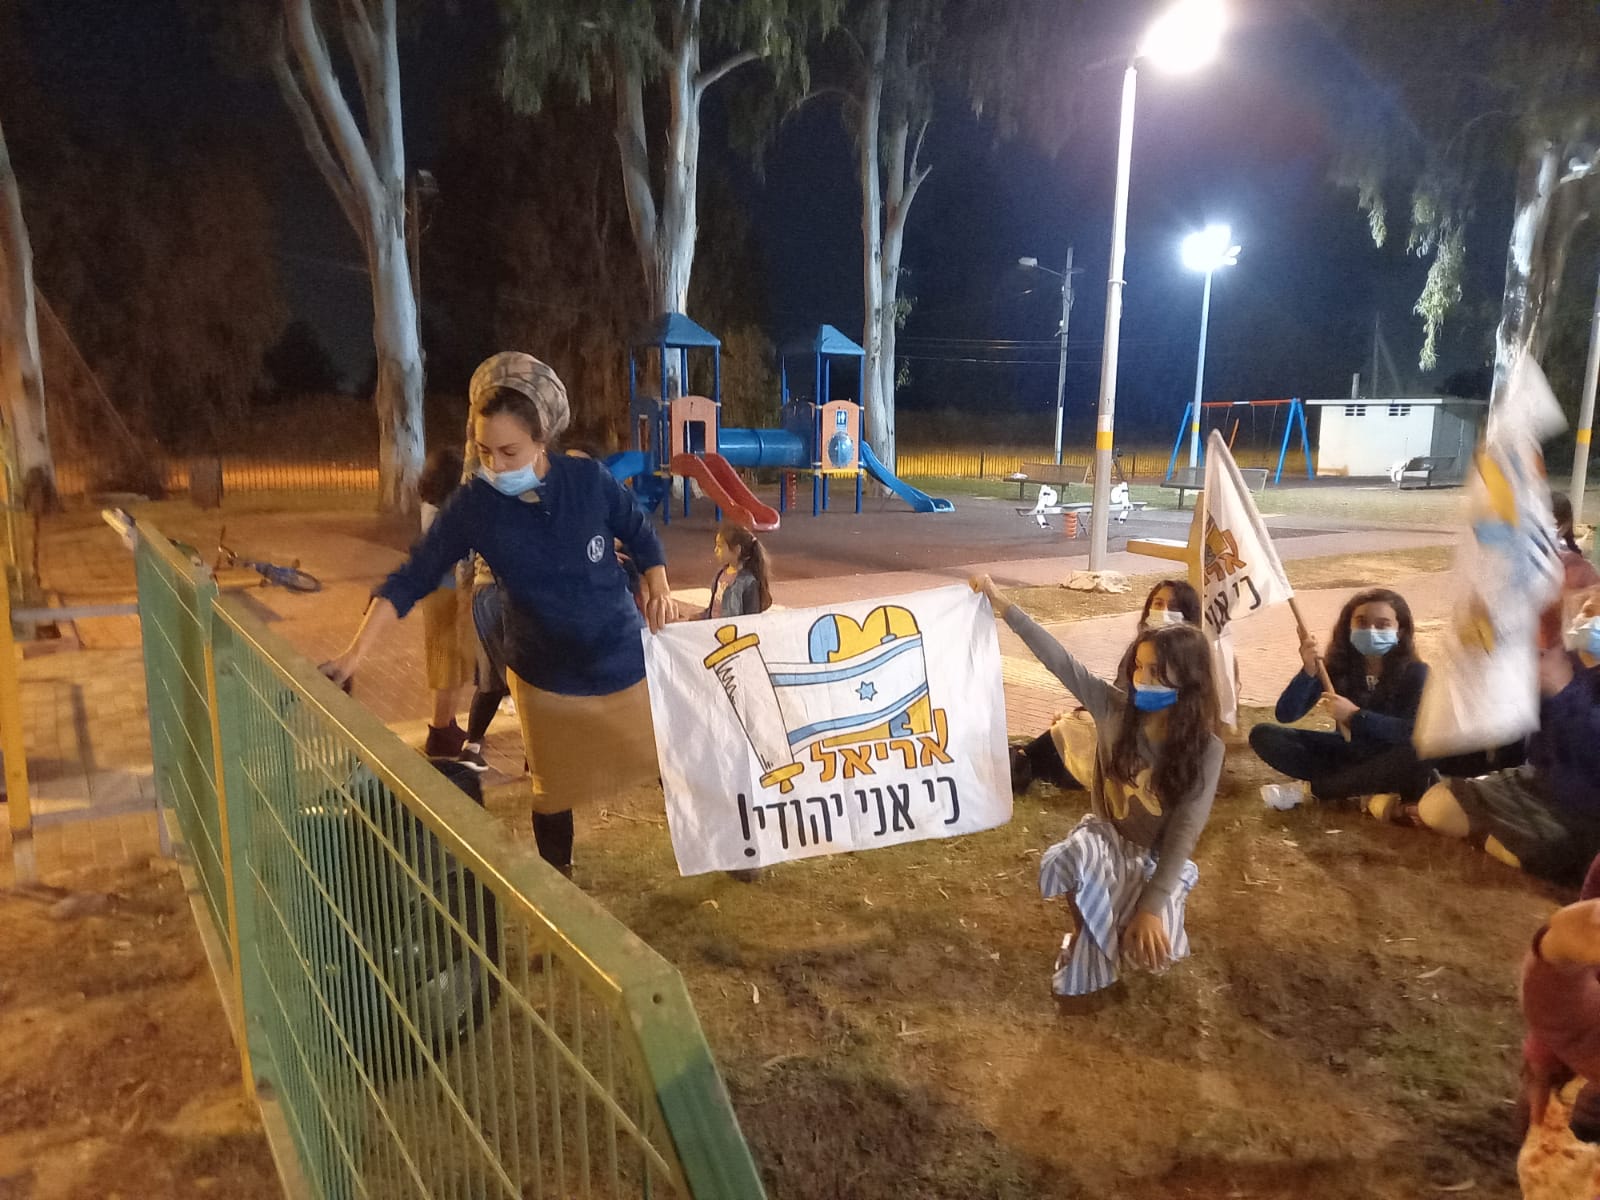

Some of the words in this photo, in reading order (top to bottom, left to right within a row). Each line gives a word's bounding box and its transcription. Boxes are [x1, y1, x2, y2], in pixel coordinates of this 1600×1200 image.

[1232, 575, 1262, 611] כי
[810, 708, 954, 782] אריאל
[737, 793, 844, 857] יהודי!
[854, 783, 915, 836] אני
[922, 776, 960, 825] כי
